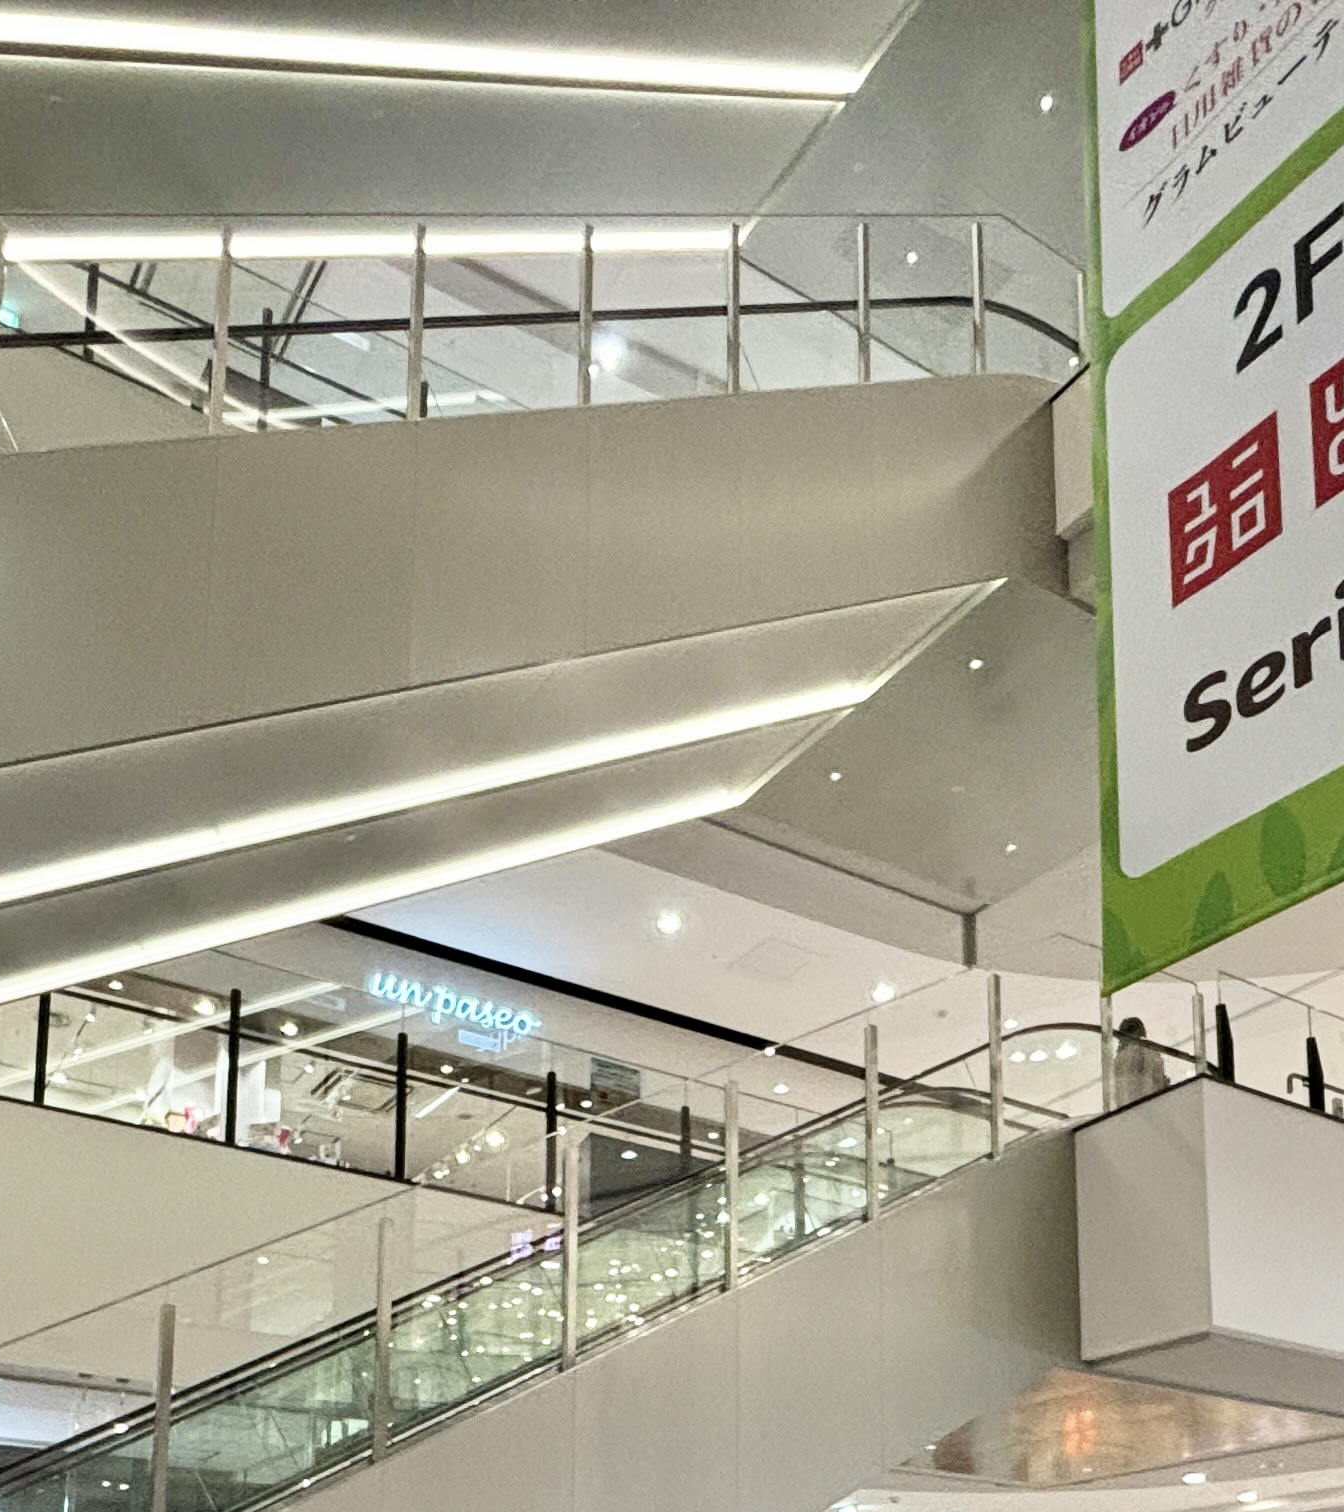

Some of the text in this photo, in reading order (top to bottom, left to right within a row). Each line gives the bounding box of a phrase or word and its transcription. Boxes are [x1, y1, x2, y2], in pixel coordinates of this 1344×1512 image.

[1233, 202, 1344, 375] 2F
[368, 972, 542, 1035] un paseo
